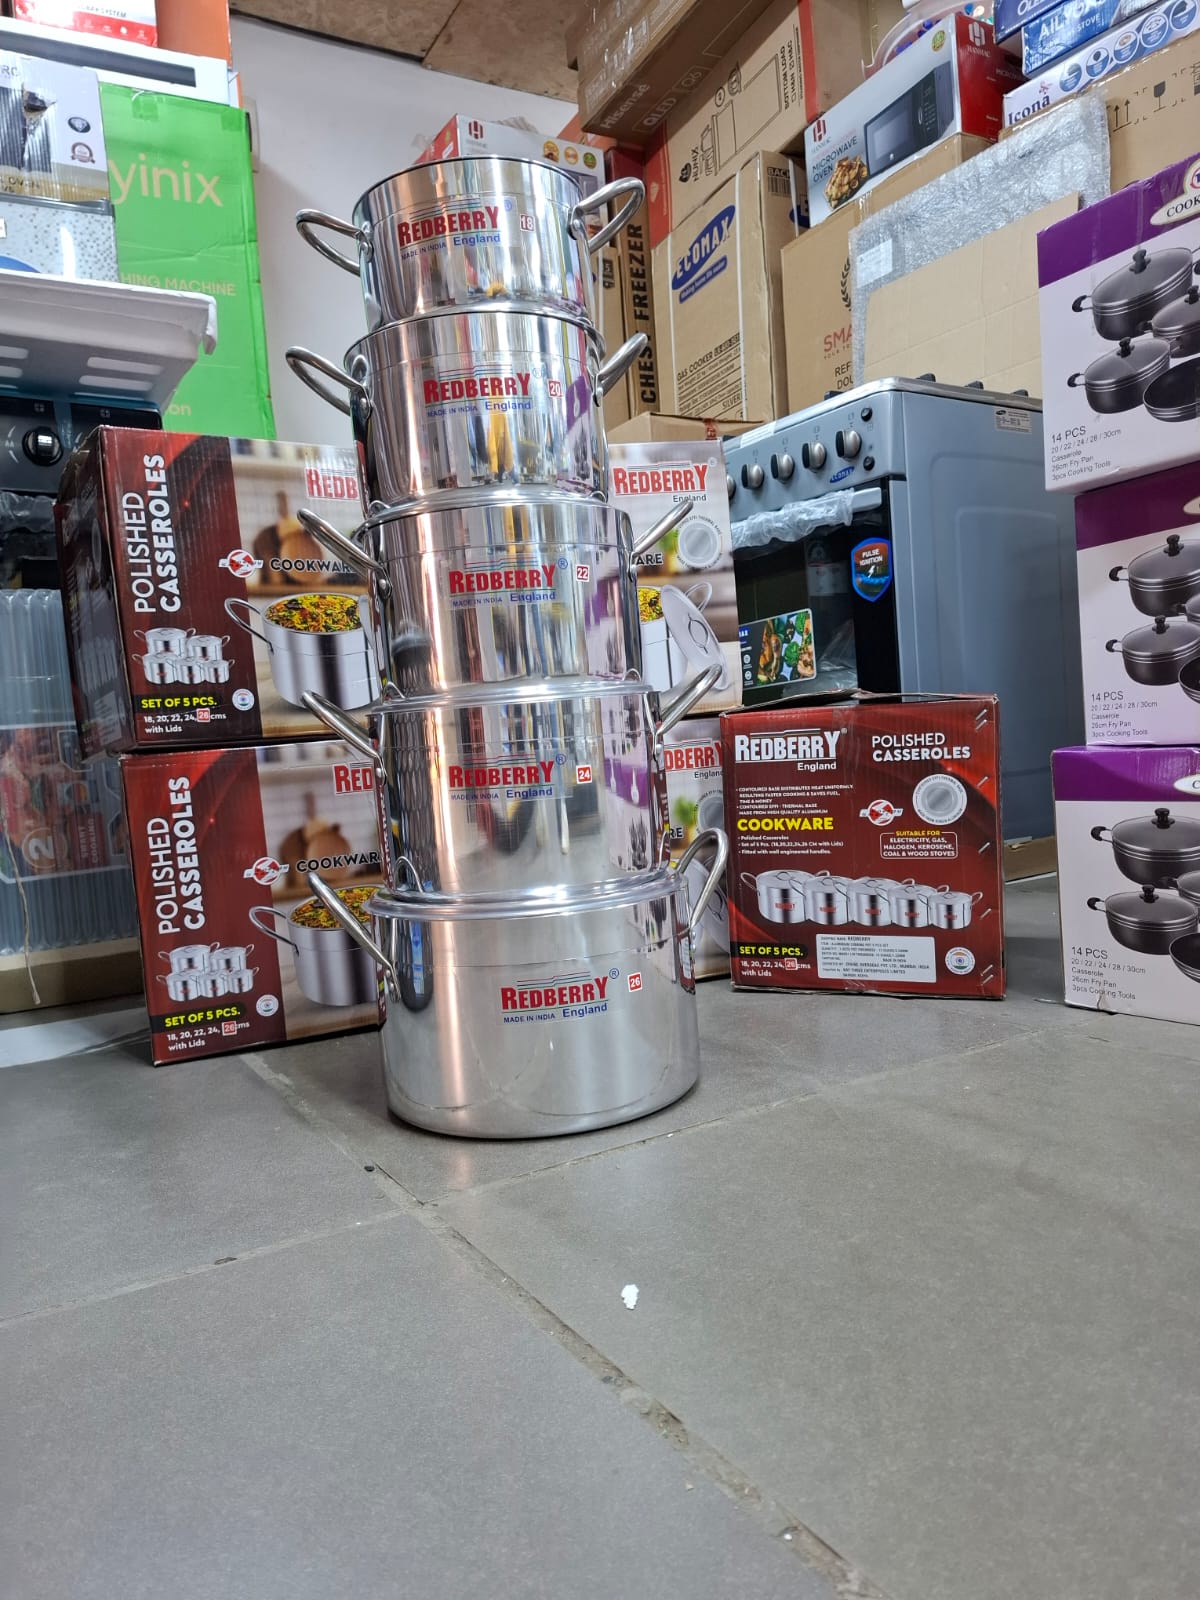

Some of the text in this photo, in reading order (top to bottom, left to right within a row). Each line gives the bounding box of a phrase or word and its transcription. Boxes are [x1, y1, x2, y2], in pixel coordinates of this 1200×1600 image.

[600, 84, 651, 128] Hisense
[812, 135, 857, 174] MICROWAVE
[813, 164, 833, 183] OVEN
[397, 206, 499, 247] REDBERRY
[520, 216, 534, 231] 18
[453, 233, 500, 247] England
[676, 216, 730, 279] ECOMAX
[165, 277, 237, 297] MACHINE
[627, 223, 657, 404] CHES FREEZER
[677, 351, 713, 381] GAS COOKER
[423, 372, 531, 404] REDBERRY
[549, 383, 562, 396] 20
[485, 400, 531, 412] England
[1052, 426, 1086, 444] 14 PCS
[1081, 455, 1094, 465] Pan
[613, 464, 708, 495] REDBERRY
[672, 493, 707, 503] England
[144, 453, 182, 613] CASSEROLES
[122, 491, 156, 614] POLISHED
[636, 553, 663, 566] ARE
[862, 548, 880, 559] PULSE
[270, 557, 352, 573] COOKWAR
[859, 555, 883, 566] IGNITION
[448, 563, 555, 594] REDBERRY
[577, 567, 588, 579] 22
[510, 592, 556, 604] England
[141, 697, 217, 709] SET OF 5 PCS.
[1091, 691, 1124, 702] 14 PCS
[144, 715, 155, 723] 18,
[156, 715, 169, 723] 20,
[170, 713, 183, 722] 22,
[145, 725, 182, 734] with Lids
[735, 730, 840, 762] REDBERRY
[872, 732, 945, 748] POLISHED
[872, 747, 971, 762] CASSEROLES
[448, 760, 554, 788] REDBERRY
[578, 768, 591, 780] 24
[797, 761, 837, 772] England
[333, 765, 374, 793] RED
[506, 787, 553, 800] England
[737, 817, 834, 831] COOKWARE
[169, 776, 206, 930] CASSEROLES
[296, 851, 382, 872] COOKWAR
[146, 817, 180, 935] POLISHED
[740, 946, 756, 954] SET
[773, 947, 780, 955] 5
[782, 947, 804, 956] PCS.
[1072, 946, 1108, 960] 14 PCS
[1127, 965, 1146, 974] 30cm
[629, 977, 641, 988] 26
[1103, 980, 1117, 988] Pan
[500, 976, 609, 1010] REDBERRY
[165, 1007, 240, 1027] SET OF 5 PCS.
[535, 1012, 556, 1020] INDIA
[562, 1002, 608, 1018] England
[180, 1031, 192, 1039] 20,
[168, 1039, 205, 1051] with Lids
